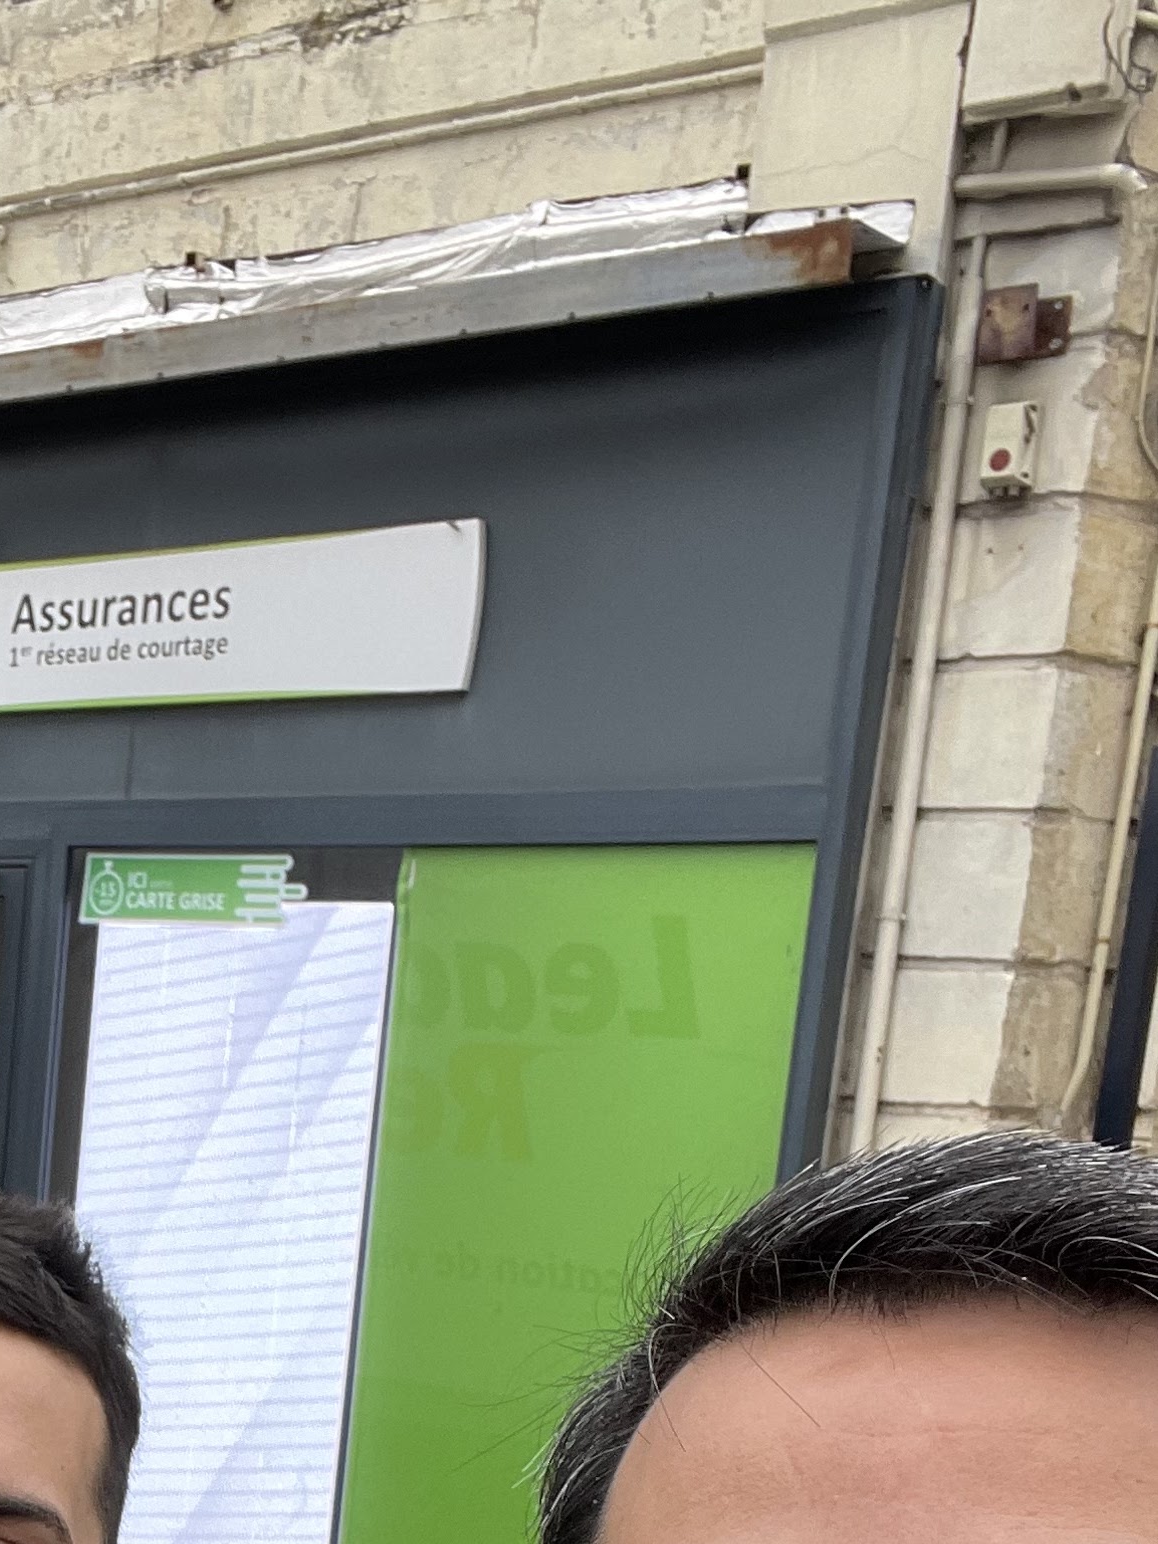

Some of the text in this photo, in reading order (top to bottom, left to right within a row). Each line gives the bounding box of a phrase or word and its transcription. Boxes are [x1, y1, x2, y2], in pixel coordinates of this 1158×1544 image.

[11, 585, 232, 634] Assurances
[36, 642, 102, 666] réseau
[106, 638, 132, 662] de
[137, 635, 229, 661] courtage
[125, 891, 226, 911] CARTE GRISE
